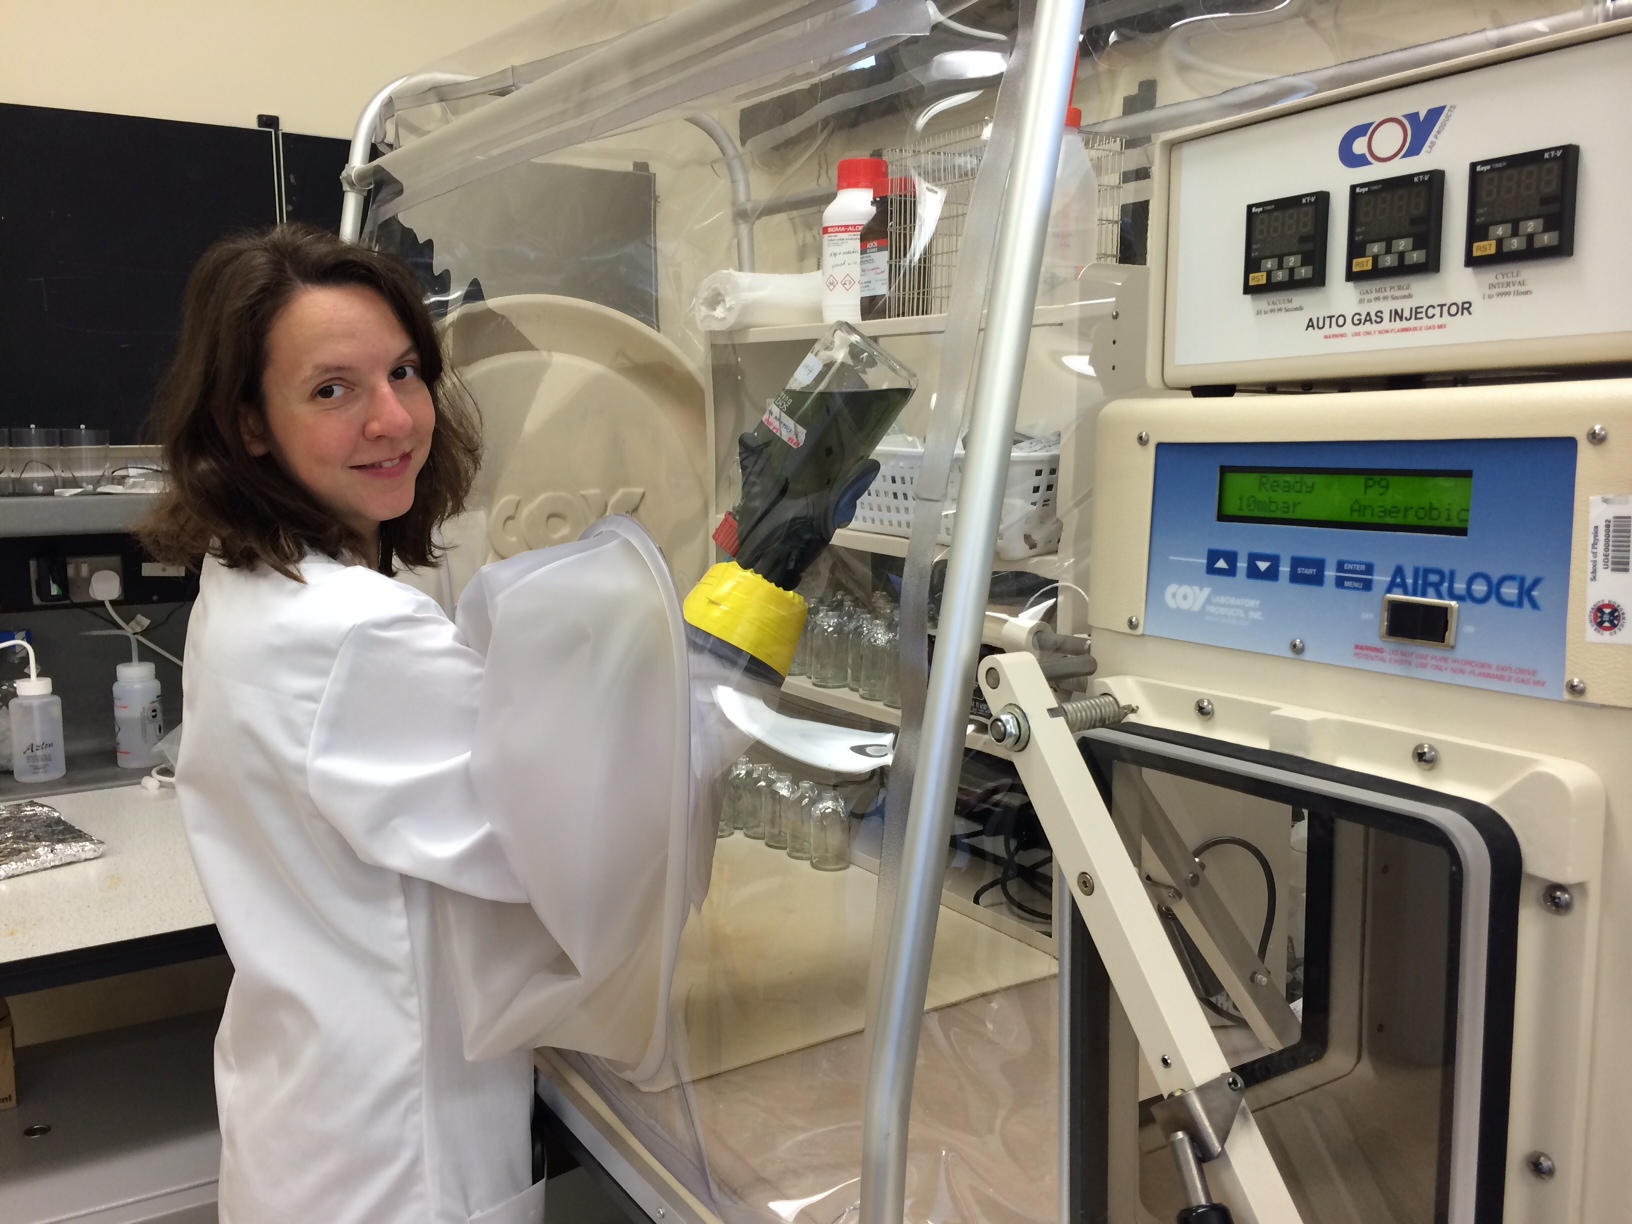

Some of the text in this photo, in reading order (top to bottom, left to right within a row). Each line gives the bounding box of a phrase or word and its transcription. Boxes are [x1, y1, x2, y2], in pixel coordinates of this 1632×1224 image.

[1426, 104, 1457, 154] LAB PRODUCTS
[1338, 105, 1447, 168] COY
[1497, 227, 1503, 236] 4
[1528, 223, 1534, 232] 2
[1373, 245, 1378, 253] 4
[1399, 241, 1405, 251] 2
[1476, 244, 1493, 253] RST
[1511, 239, 1517, 249] 3
[1267, 260, 1272, 269] 4
[1289, 257, 1295, 266] 2
[1355, 260, 1370, 268] RST
[1385, 257, 1391, 266] 3
[1251, 275, 1265, 283] RST
[1278, 272, 1283, 280] 3
[1495, 271, 1521, 280] CYCLE
[1360, 284, 1411, 296] GAS MIX PURGE
[1489, 281, 1527, 291] INTERVAL
[1391, 293, 1413, 301] Seconds
[1496, 290, 1512, 299] 9999
[1513, 288, 1533, 297] Hours
[1267, 298, 1293, 306] VACUUM
[1284, 305, 1304, 313] Seconds
[1306, 301, 1472, 331] AUTO GAS INJECTOR
[1378, 326, 1423, 335] NON-FLAMMABLE
[1259, 476, 1390, 496] Ready P9
[1238, 496, 1470, 523] 10mbar Anaerobic
[1603, 519, 1612, 570] UOE0000082
[1344, 563, 1366, 571] ENTER
[1590, 560, 1598, 582] School
[1344, 581, 1363, 589] MENU
[1385, 564, 1545, 611] AIRLOCK
[1165, 584, 1212, 612] COY
[1211, 595, 1261, 608] LABORATORY
[1401, 650, 1414, 658] NOT
[1416, 652, 1429, 660] USE
[1431, 655, 1450, 663] PURE
[1496, 664, 1538, 677] EXPLOSIVE
[1354, 652, 1386, 663] POTENTIAL
[1431, 664, 1449, 672] ONLY
[1450, 667, 1513, 682] NON-FLAMMABLE
[1515, 677, 1530, 685] GAS
[1532, 680, 1547, 688] MIX
[23, 742, 54, 754] Azlon
